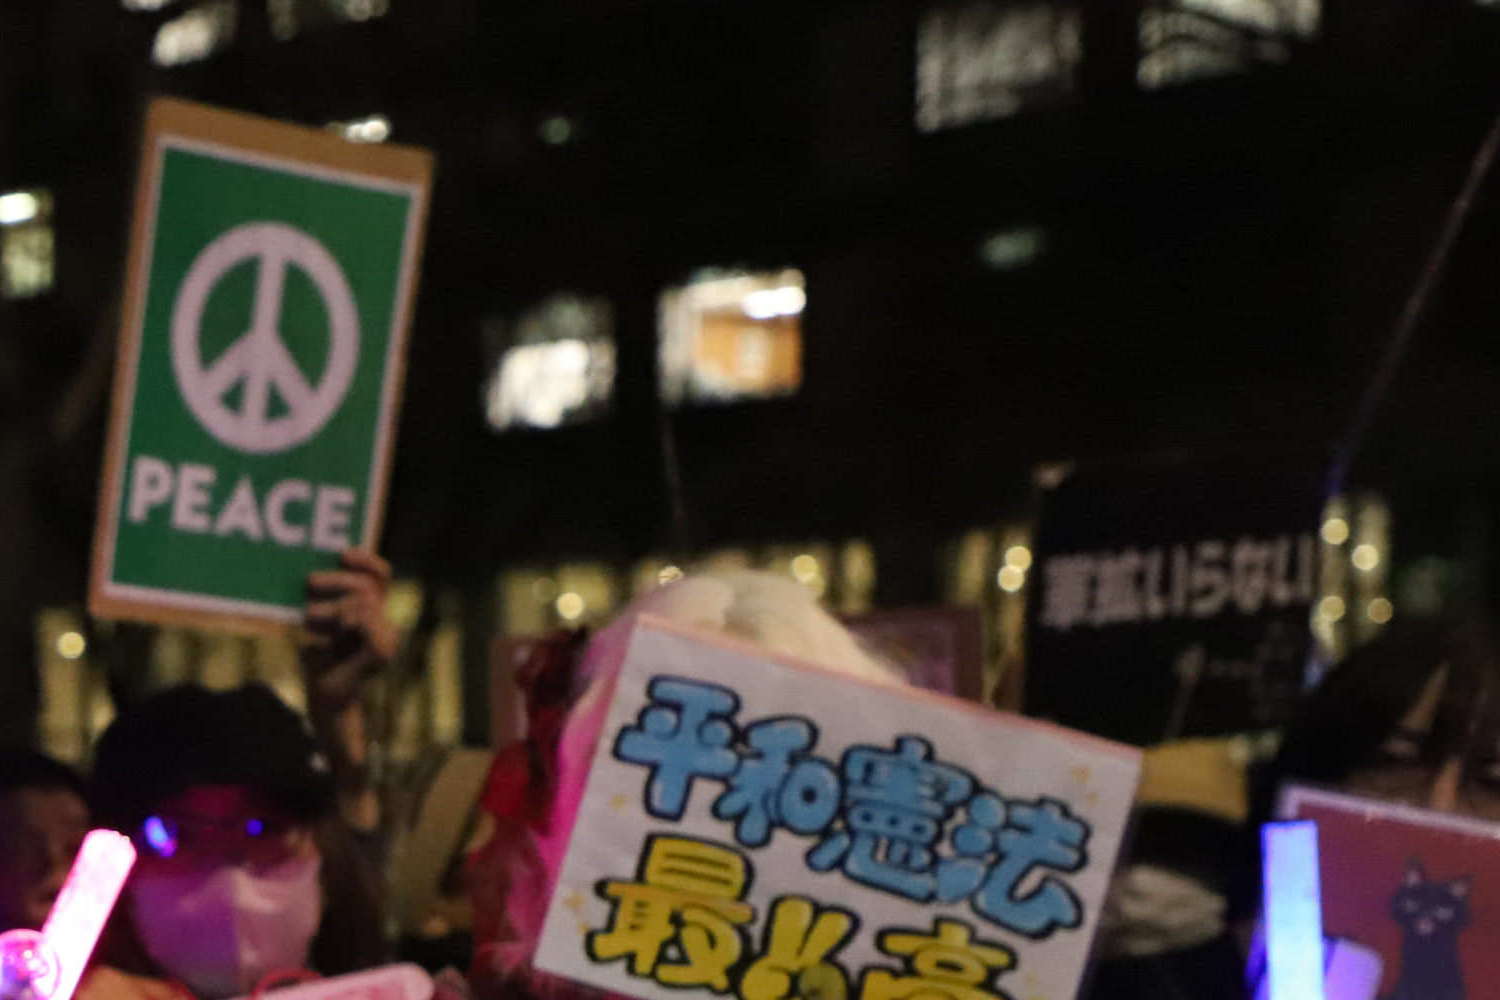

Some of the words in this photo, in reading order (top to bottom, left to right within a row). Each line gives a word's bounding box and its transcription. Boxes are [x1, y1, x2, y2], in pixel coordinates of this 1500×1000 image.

[127, 455, 355, 553] PEACE
[612, 675, 1092, 940] 平和憲法
